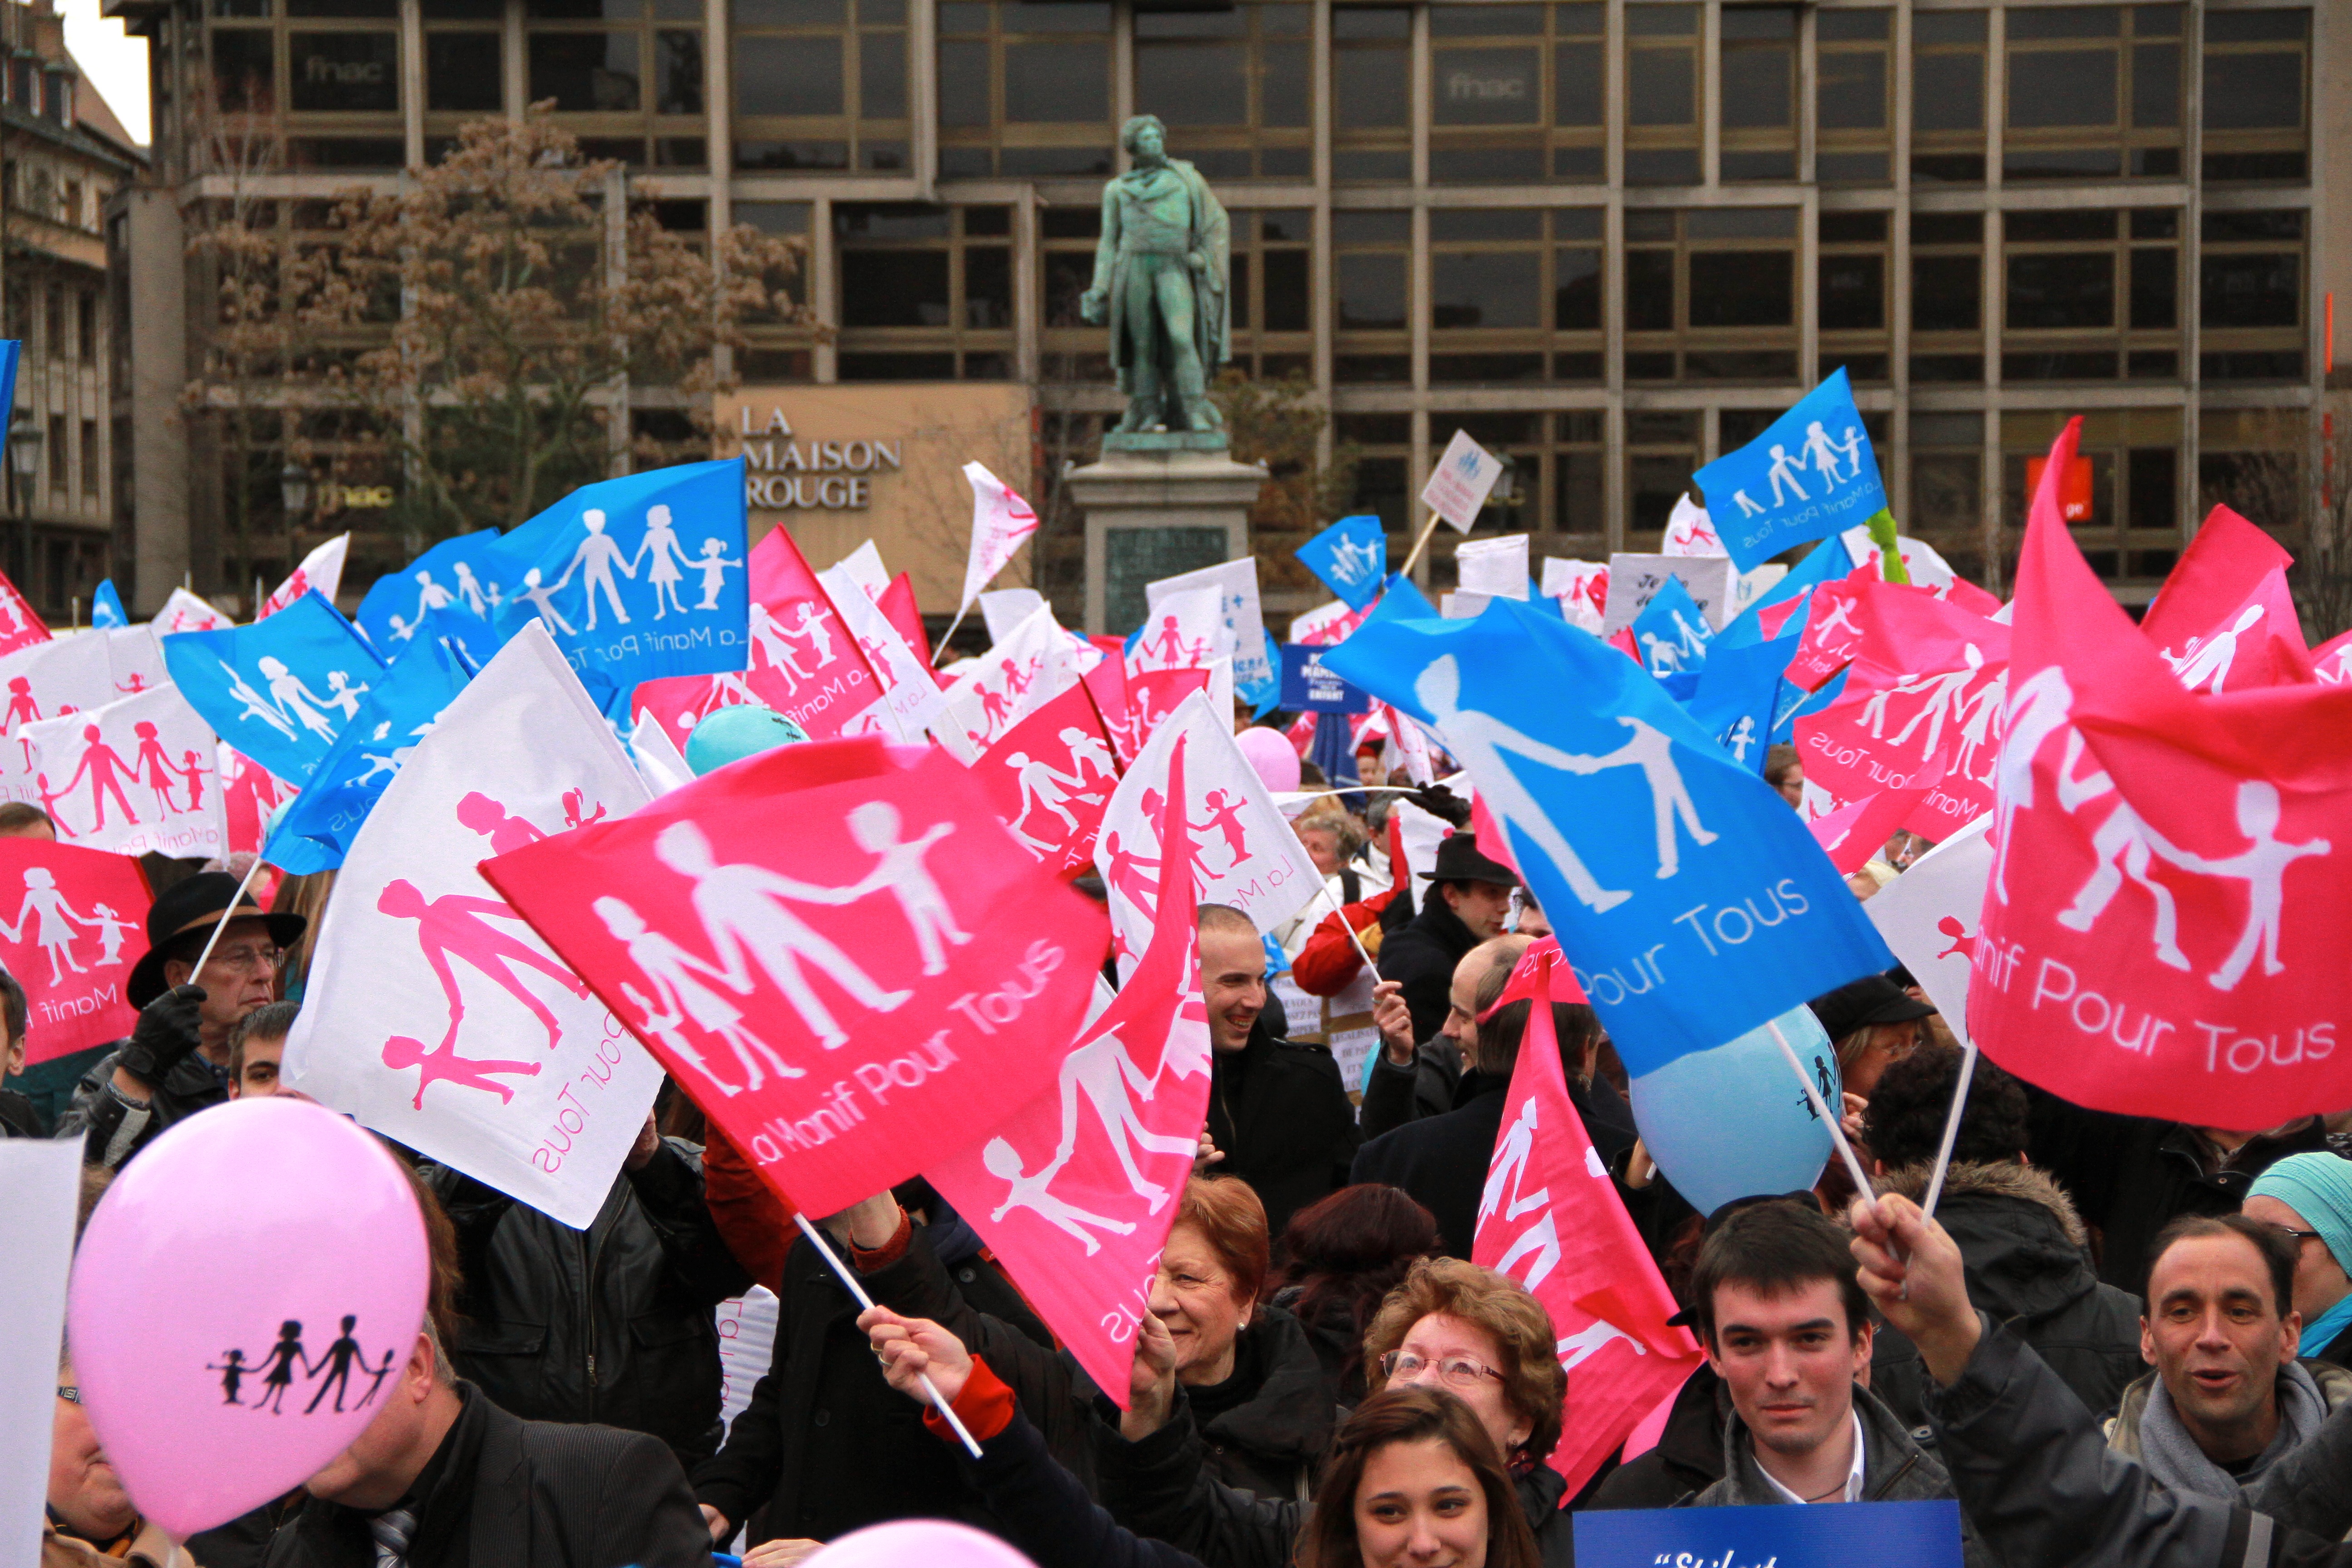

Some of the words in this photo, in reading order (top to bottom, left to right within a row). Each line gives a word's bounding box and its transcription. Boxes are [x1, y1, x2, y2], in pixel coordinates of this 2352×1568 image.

[742, 407, 792, 436] LA
[742, 440, 902, 473] MAISON
[746, 475, 868, 509] ROUGE
[1671, 878, 1810, 957] Tous
[2033, 956, 2176, 1058] Pour
[2194, 1021, 2337, 1073] Tous
[763, 1081, 867, 1152] Manif
[854, 1029, 961, 1106] Pour
[946, 937, 1066, 1035] Tous
